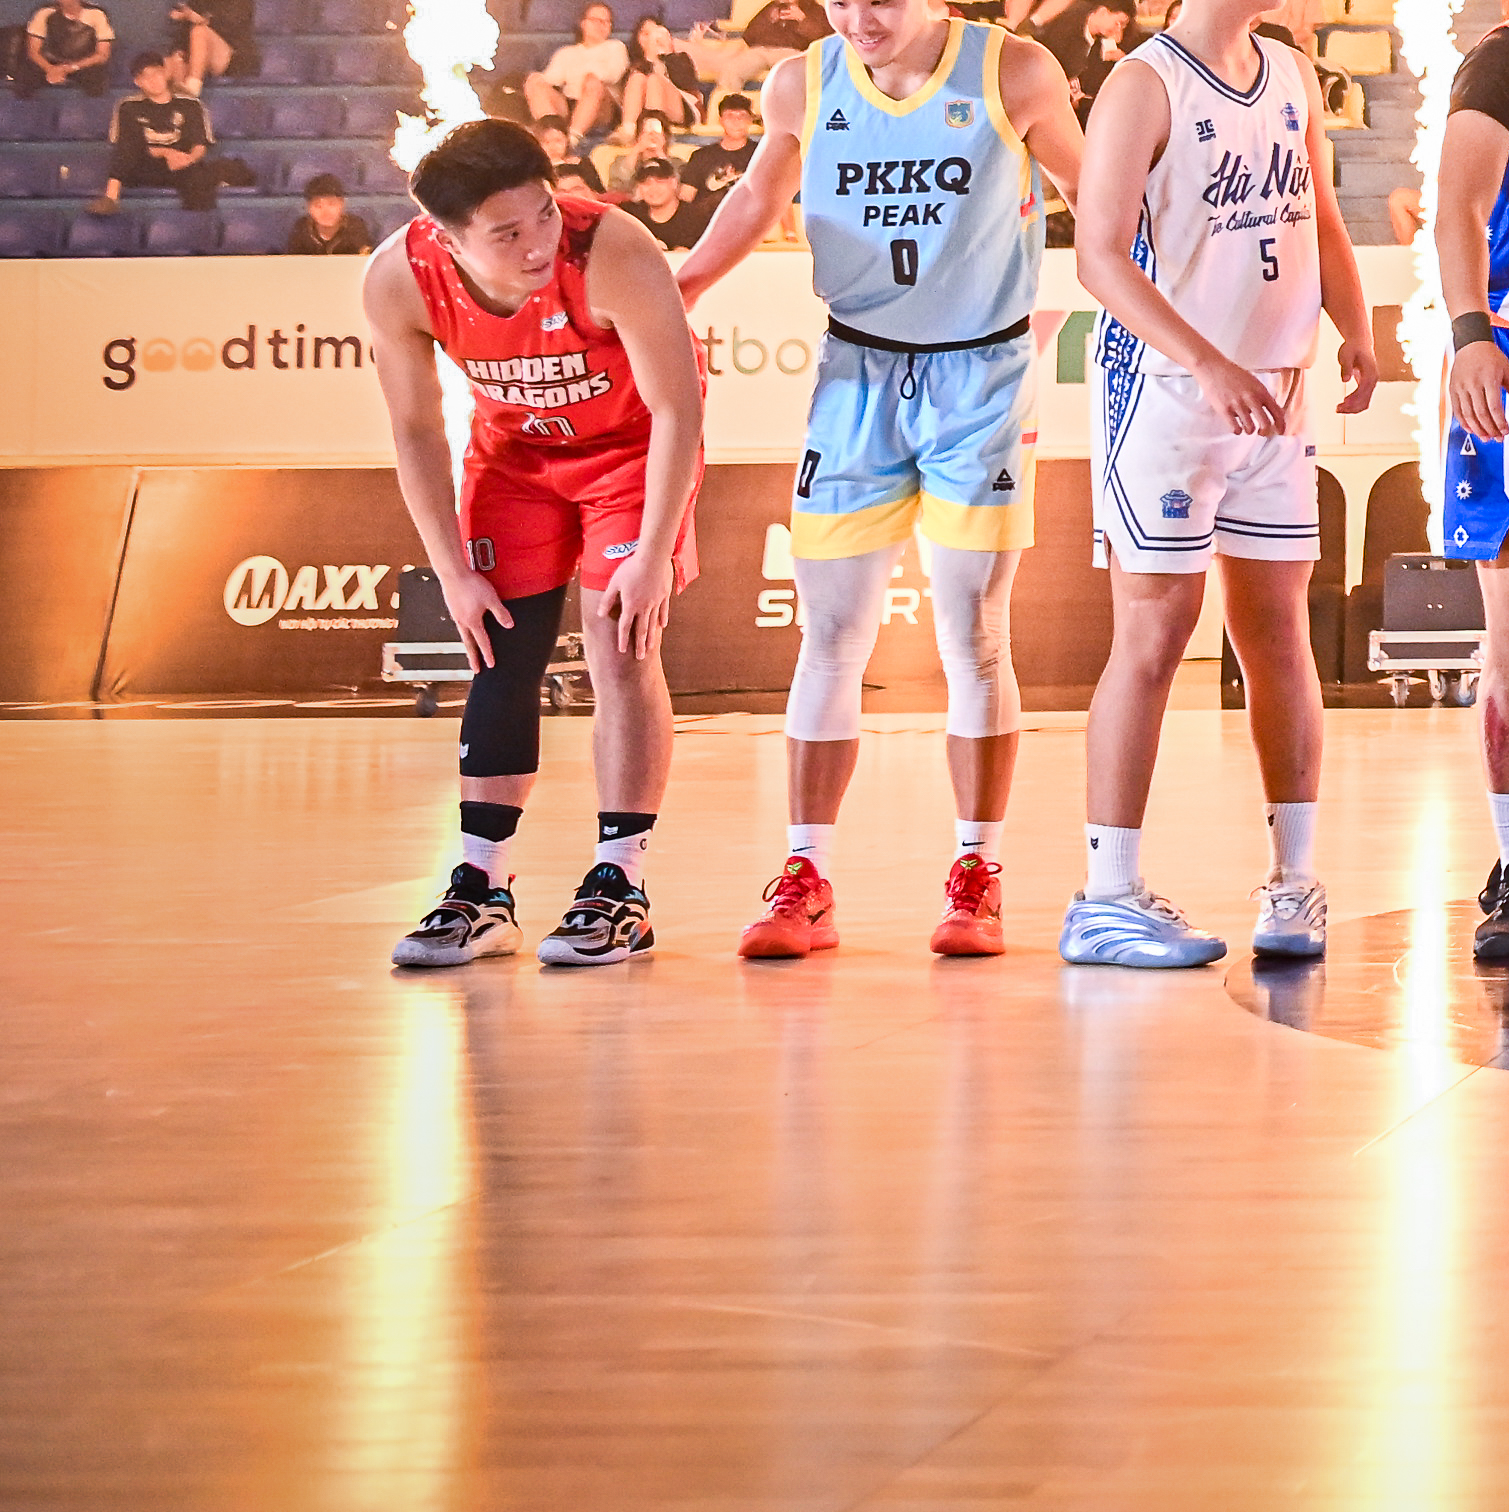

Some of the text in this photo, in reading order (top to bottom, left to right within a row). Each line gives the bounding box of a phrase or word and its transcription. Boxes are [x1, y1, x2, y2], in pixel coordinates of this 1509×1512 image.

[836, 156, 973, 196] PKKQ
[862, 202, 946, 227] PEAK
[890, 238, 920, 286] 0
[1259, 237, 1280, 282] 5
[102, 324, 379, 391] goodtim
[464, 351, 587, 384] HIDDEN
[222, 554, 392, 627] MAXX
